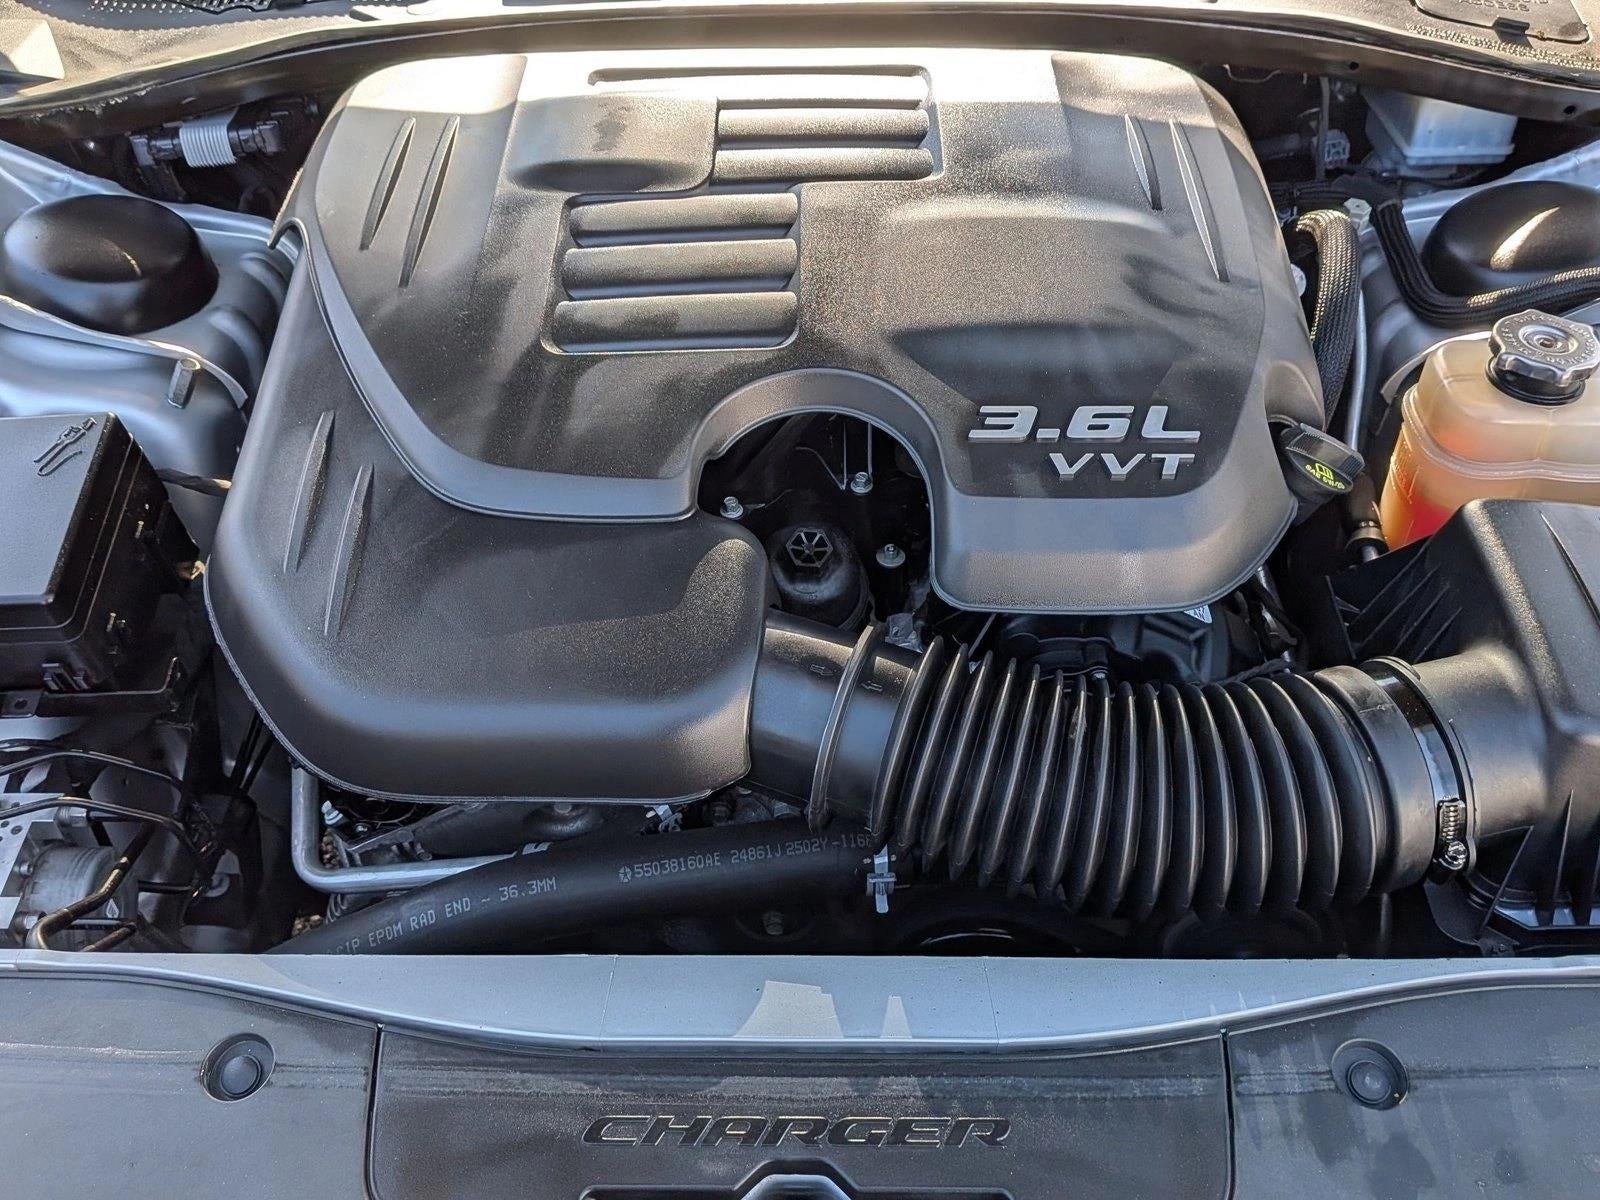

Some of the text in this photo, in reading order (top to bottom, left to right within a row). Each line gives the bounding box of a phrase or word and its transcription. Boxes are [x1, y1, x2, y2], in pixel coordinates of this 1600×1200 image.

[968, 405, 1201, 443] 3.6L
[1049, 452, 1196, 480] VVT
[368, 921, 403, 947] EPDM
[410, 910, 436, 931] RAD
[445, 897, 472, 918] END
[498, 876, 557, 902] 36.3MM
[582, 1115, 1011, 1148] CHARGER
